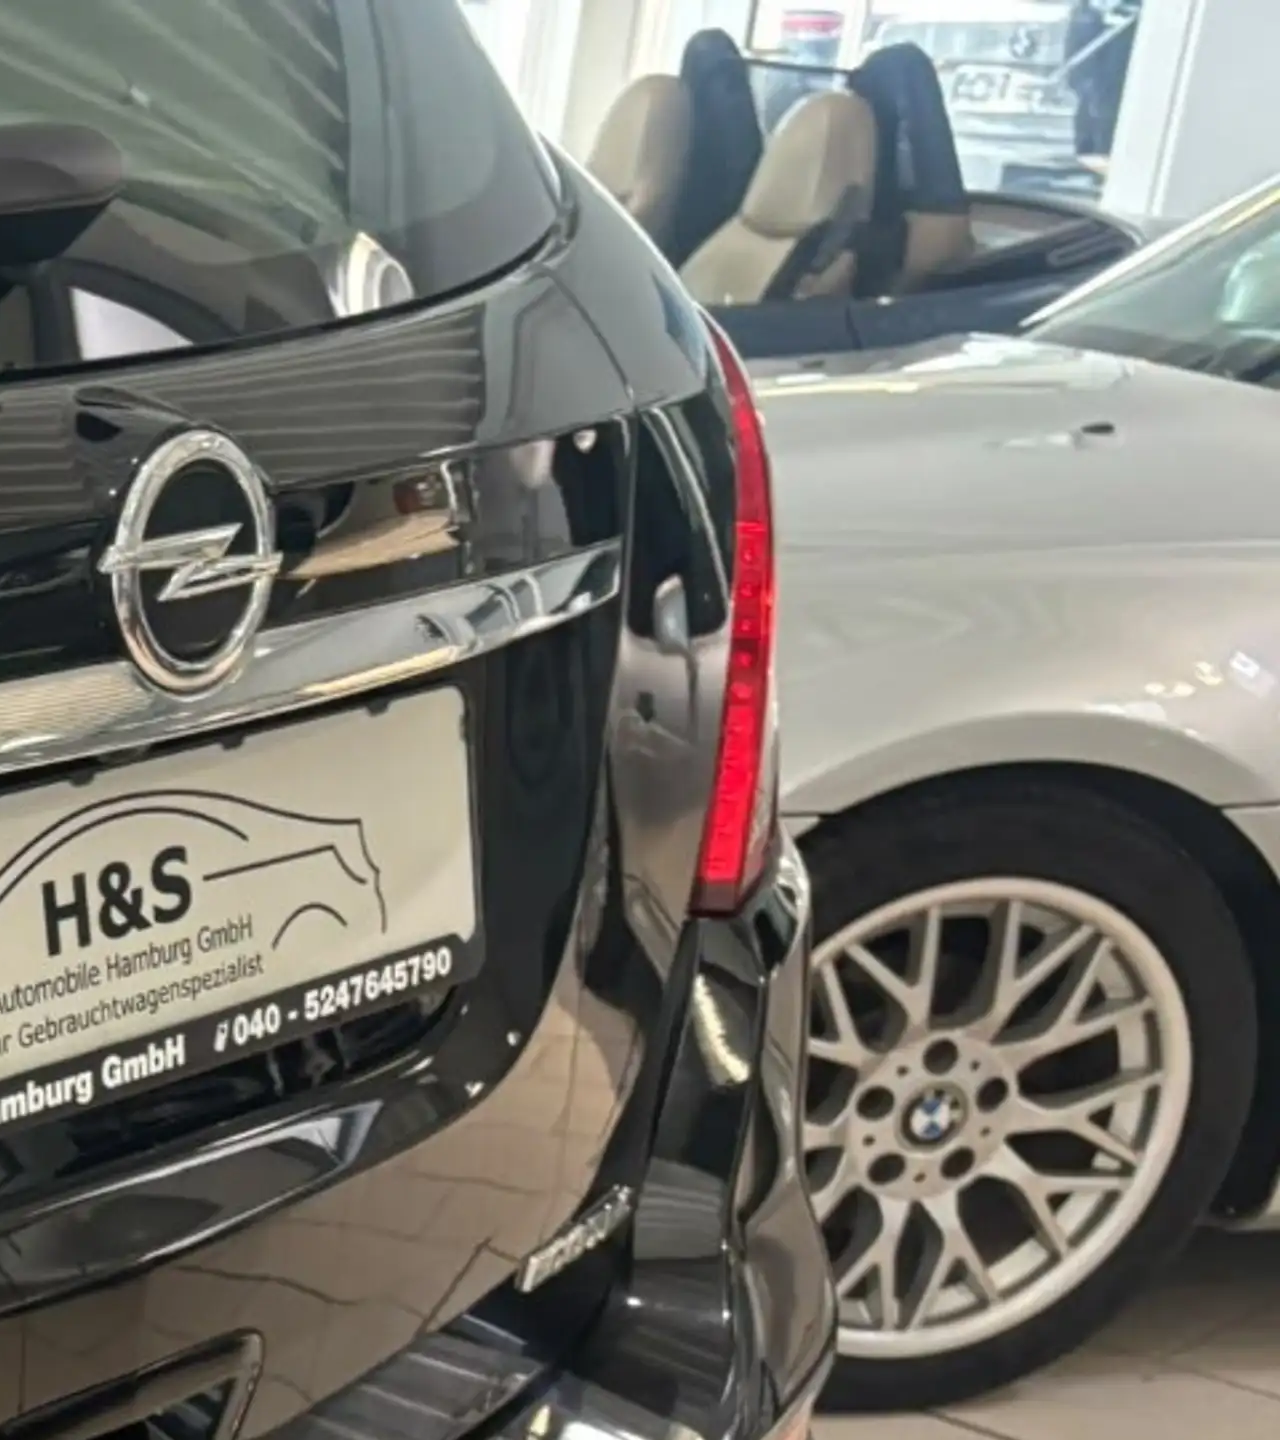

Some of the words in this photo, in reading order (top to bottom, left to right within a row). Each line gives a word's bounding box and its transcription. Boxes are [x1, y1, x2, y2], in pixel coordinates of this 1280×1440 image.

[42, 845, 192, 957] H&S
[106, 936, 191, 982] Hamburg
[197, 914, 253, 953] GmbH
[18, 953, 264, 1049] Gebrauchtwagenspezialist
[101, 1034, 185, 1089] GmbH
[232, 1003, 281, 1046] 040
[303, 946, 453, 1020] 5247645790
